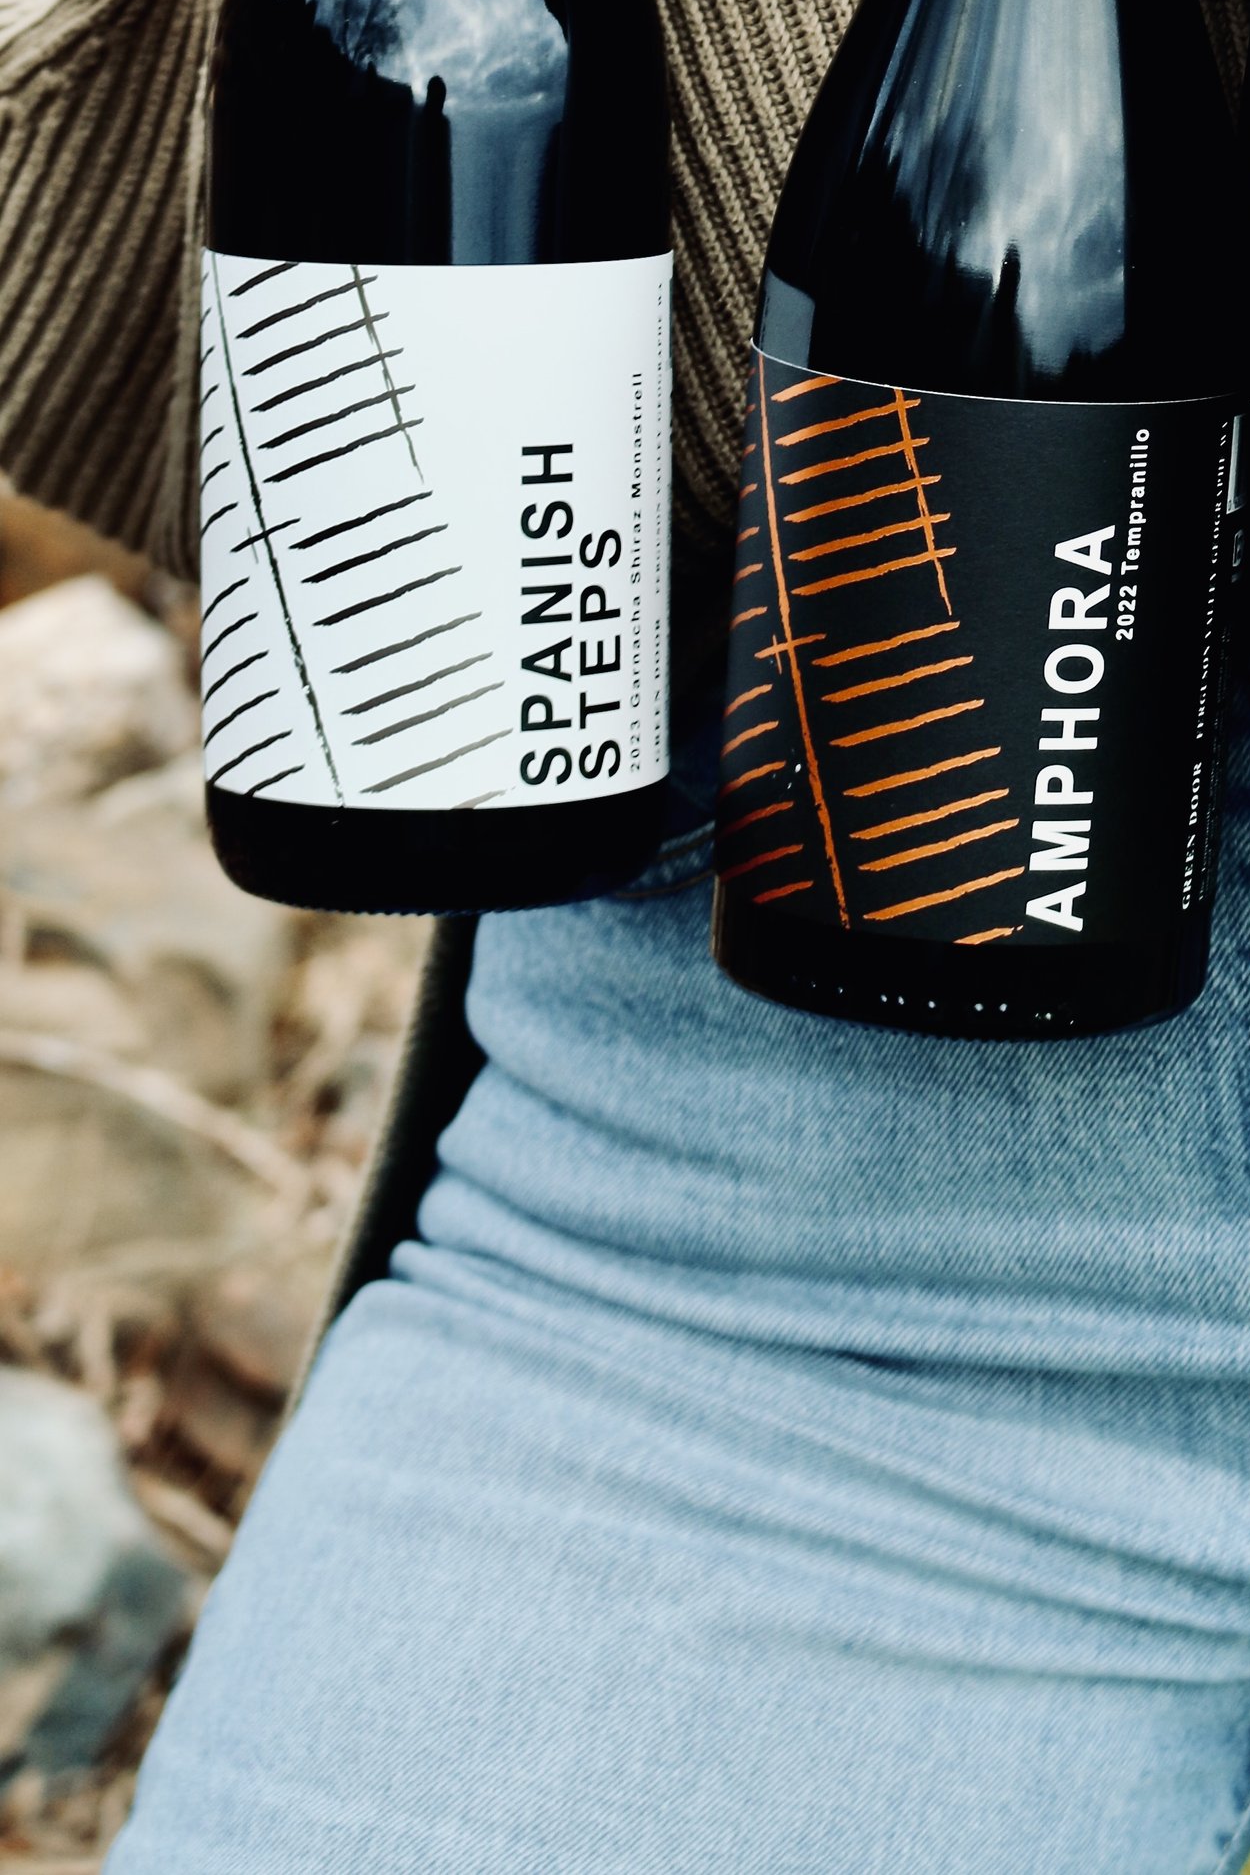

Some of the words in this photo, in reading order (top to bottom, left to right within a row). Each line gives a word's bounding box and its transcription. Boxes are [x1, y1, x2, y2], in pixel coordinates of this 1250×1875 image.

[630, 372, 644, 500] Monastrell
[630, 510, 643, 586] Shiraz
[1120, 428, 1150, 577] Tempranillo
[519, 443, 574, 786] SPANISH
[578, 528, 622, 780] STEPS
[629, 594, 642, 709] Garnacha
[1115, 584, 1138, 641] 2022
[629, 718, 642, 773] 2023
[1025, 524, 1116, 932] AMPHORA
[1187, 761, 1203, 828] DOOR
[1181, 834, 1197, 911] GREEN
